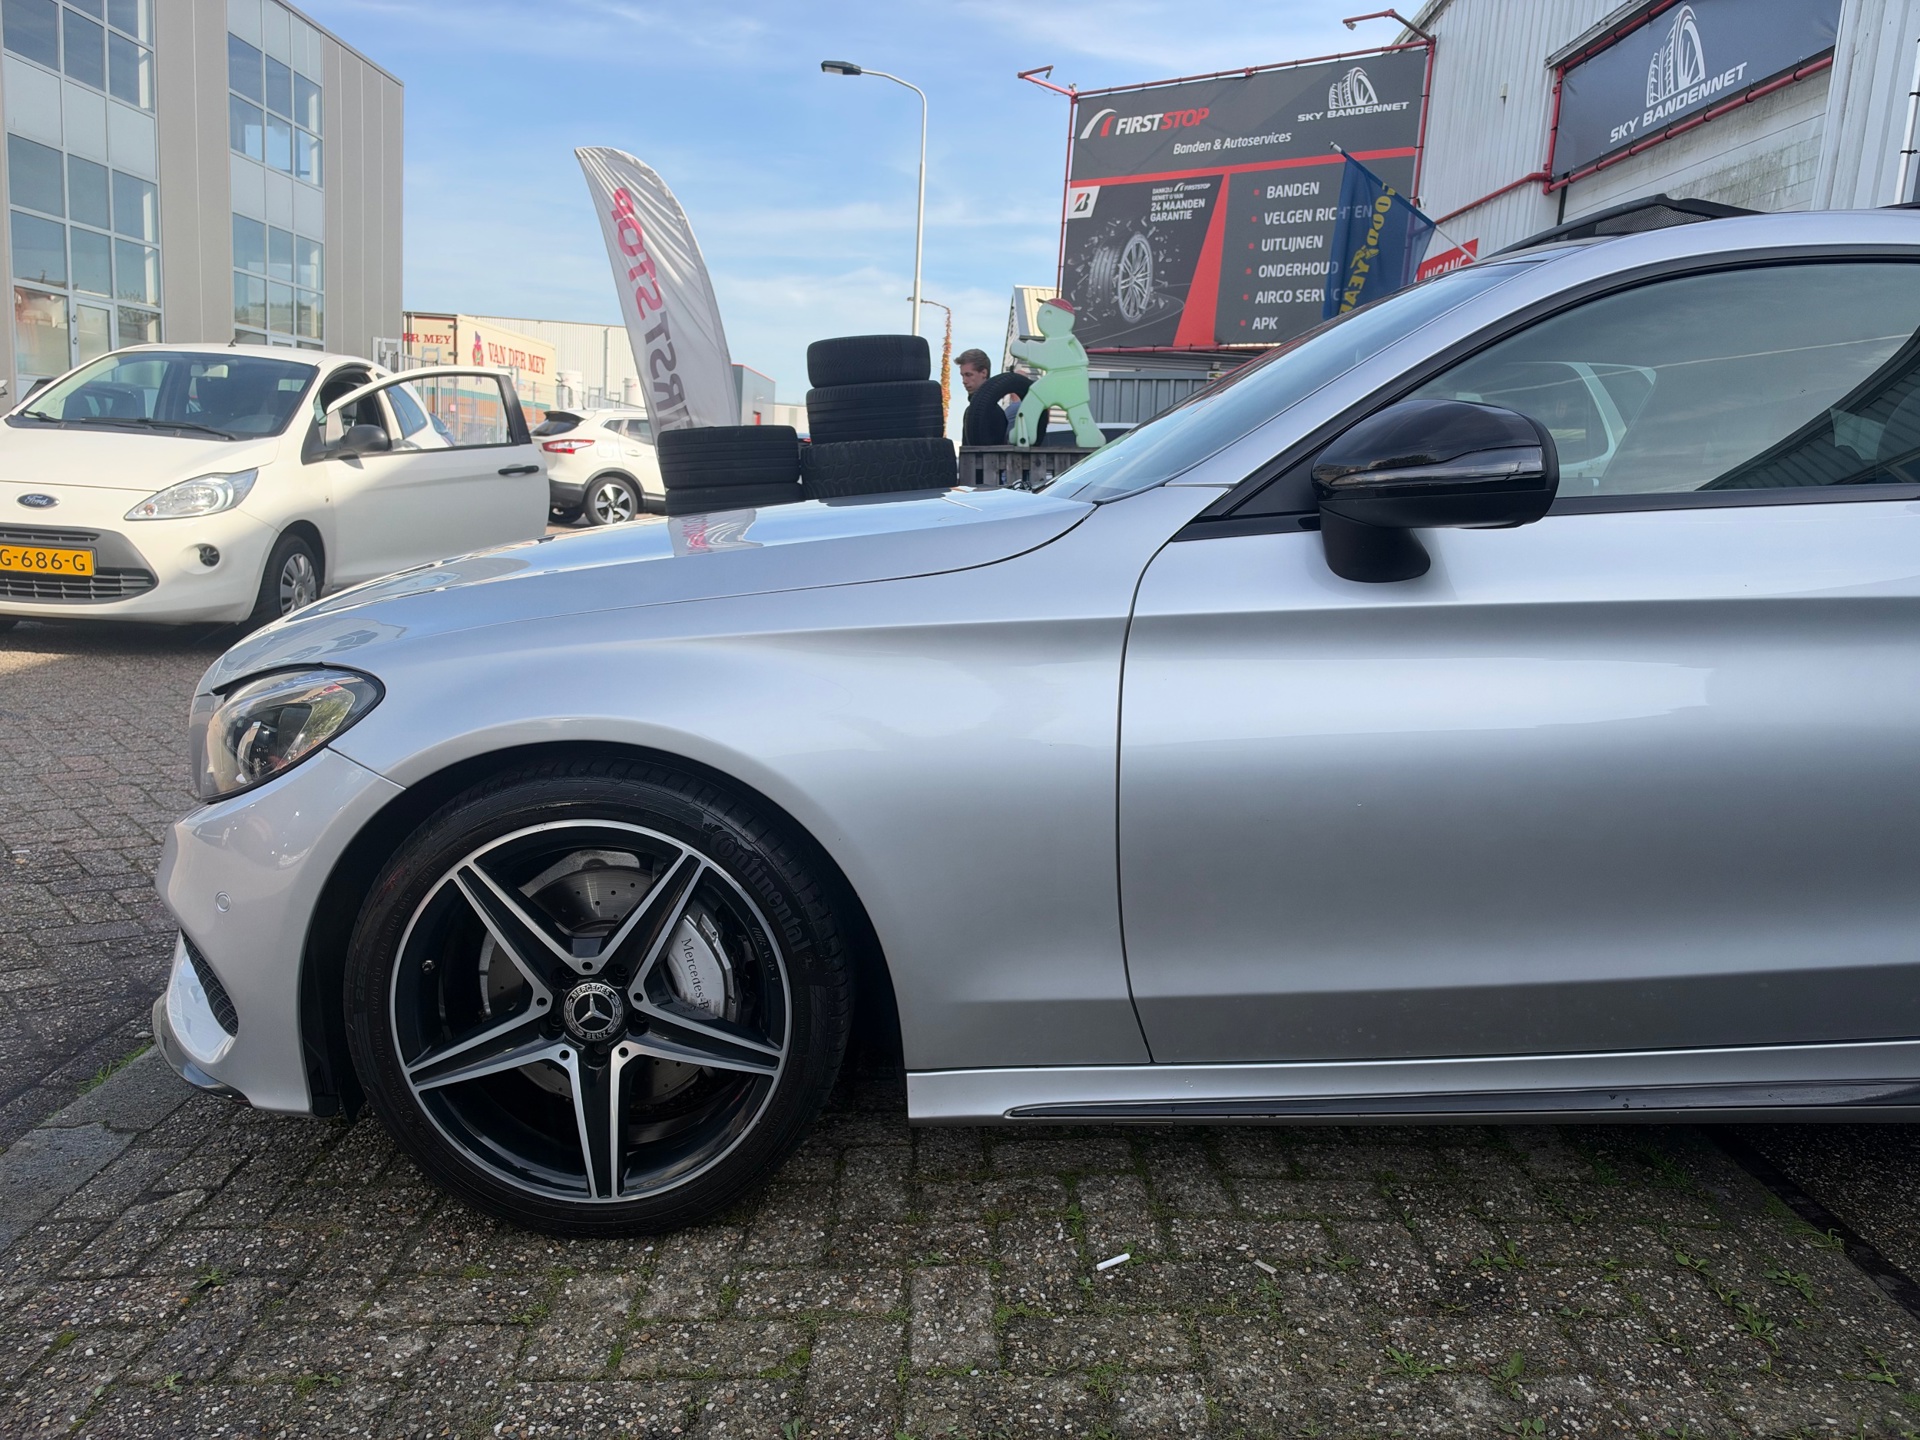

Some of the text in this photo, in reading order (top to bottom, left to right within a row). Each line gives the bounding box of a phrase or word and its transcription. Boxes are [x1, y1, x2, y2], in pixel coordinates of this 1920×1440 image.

[1610, 62, 1748, 143] SKY BANDENNET
[1297, 101, 1410, 122] SKY BANDENNET
[1173, 132, 1292, 155] Banden & Autoservices
[1266, 182, 1320, 199] BANDEN
[1151, 198, 1206, 212] 24 MAANDEN
[1150, 210, 1193, 222] GARANTIE
[1264, 209, 1313, 225] VELGEN
[1261, 235, 1323, 253] UITLIJNEN
[1258, 261, 1339, 278] ONDERHOUD
[1255, 290, 1293, 304] AIRCO
[1252, 316, 1278, 330] APK
[423, 333, 452, 345] MEY
[488, 342, 546, 375] VAN DER MEY
[25, 495, 48, 506] Ford
[0, 549, 86, 571] G-686-G
[571, 985, 611, 998] MERCEDES
[586, 1031, 608, 1040] BENZ
